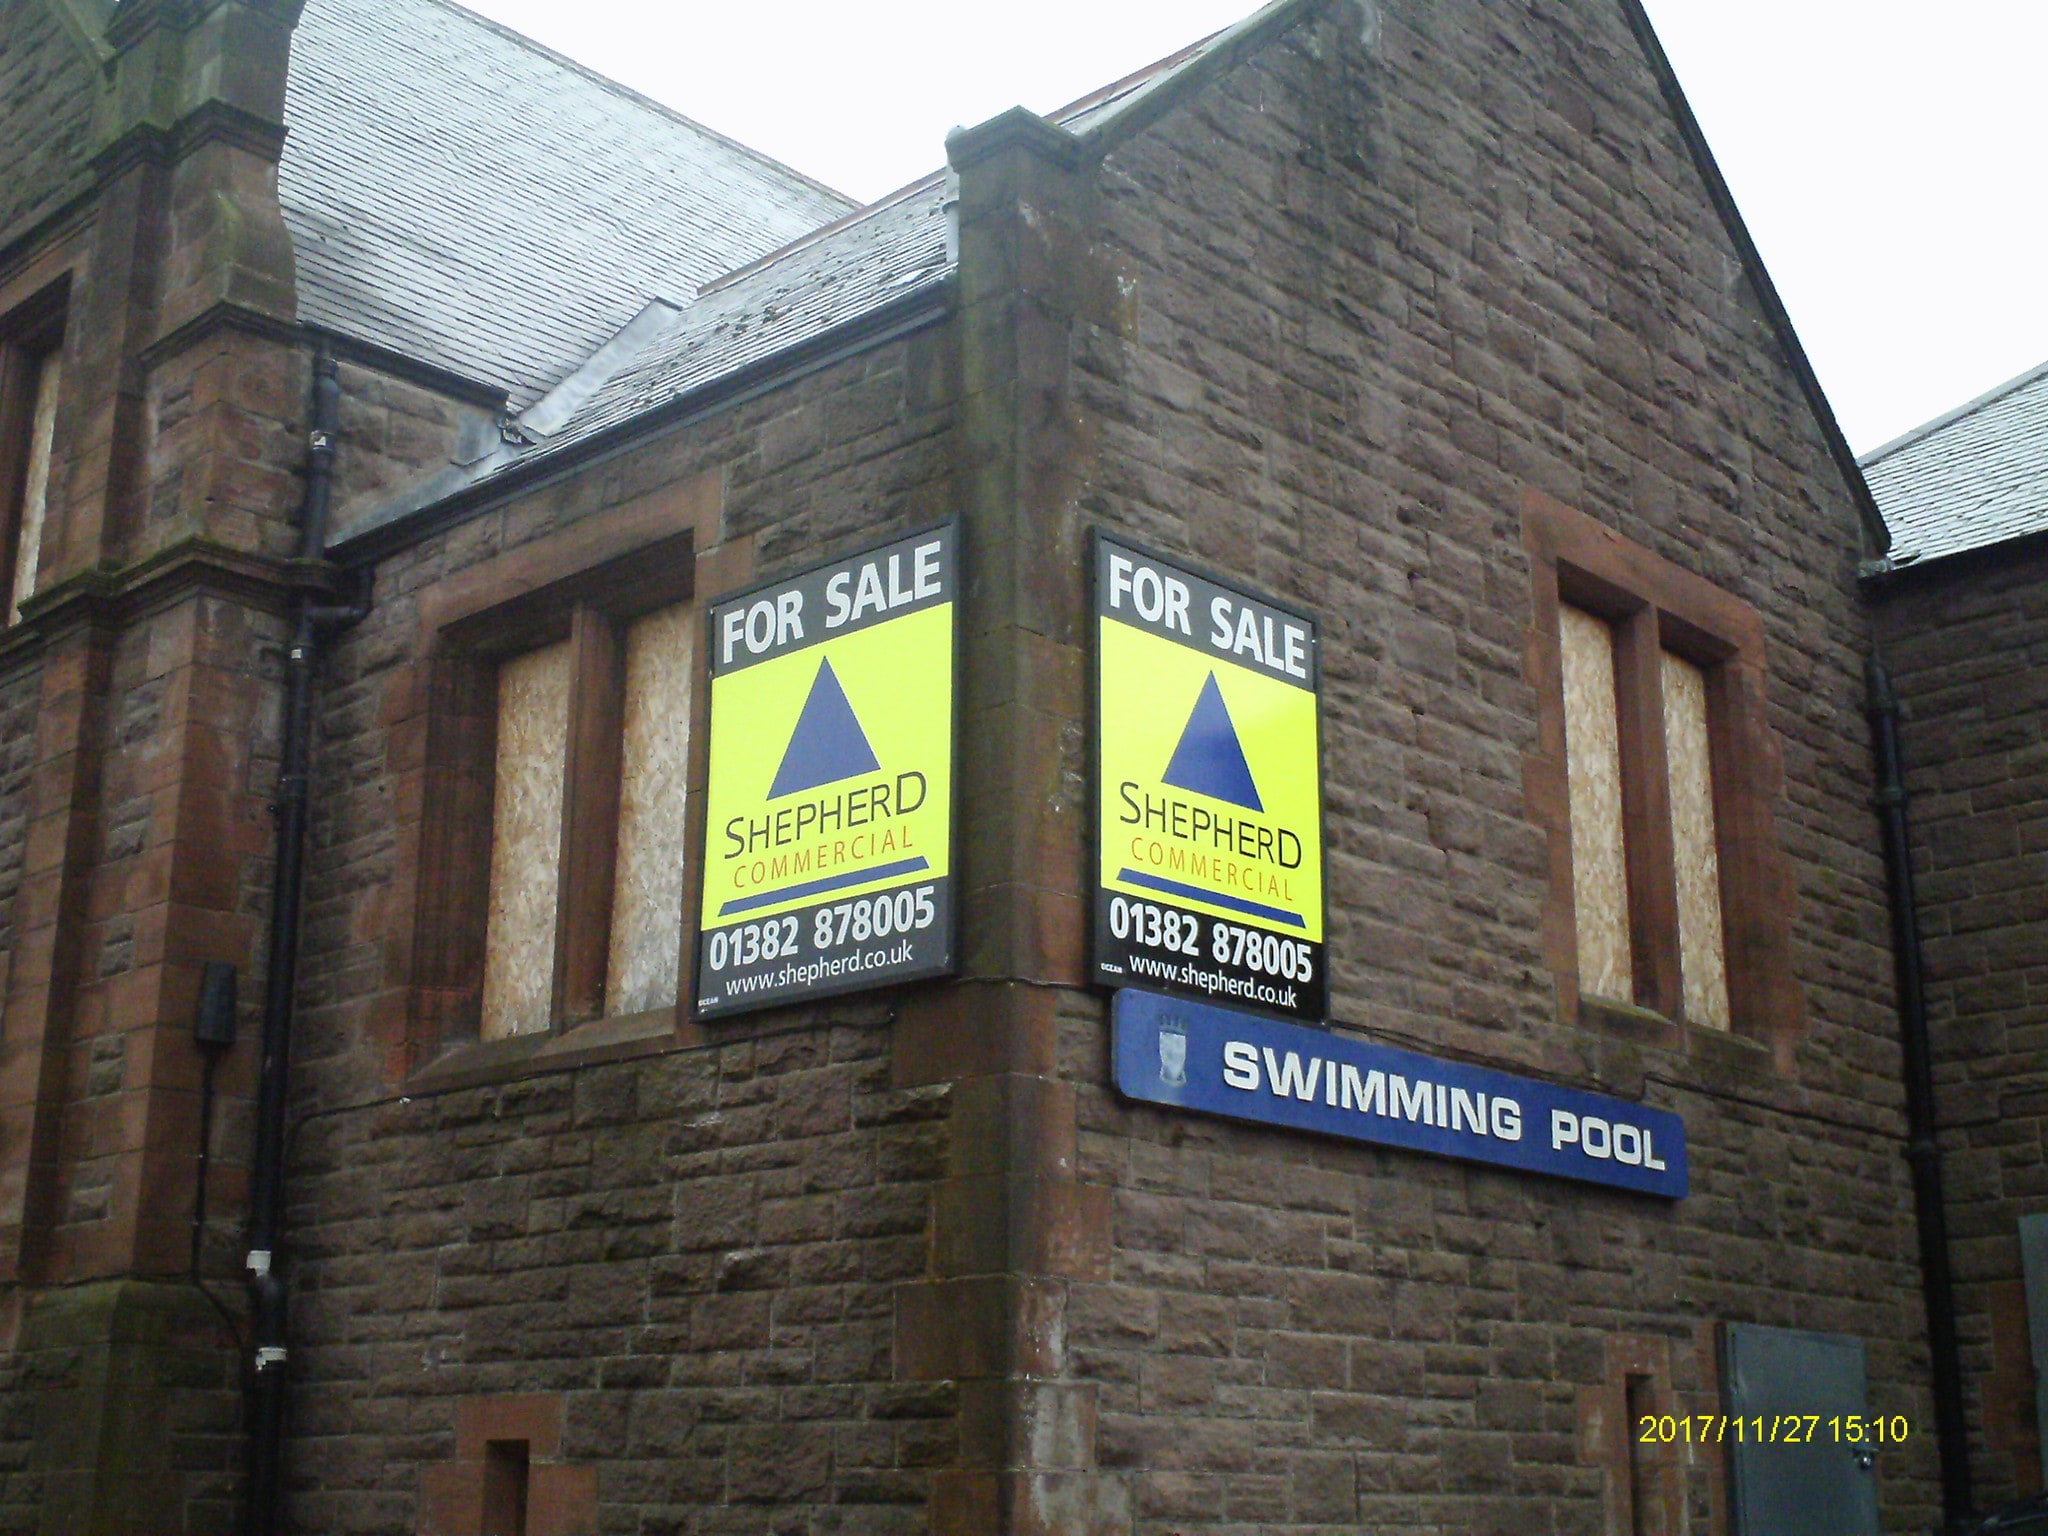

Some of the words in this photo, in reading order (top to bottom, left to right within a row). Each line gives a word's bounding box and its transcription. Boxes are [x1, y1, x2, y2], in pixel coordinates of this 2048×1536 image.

[723, 590, 804, 664] FOR
[825, 540, 941, 628] SALE
[1110, 554, 1191, 635] FOR
[1210, 596, 1306, 679] SALE
[724, 771, 927, 860] SHEPHERD
[733, 825, 913, 888] COMMERCIAL
[1119, 781, 1302, 869] SHEPHERD
[1131, 837, 1293, 901] COMMERCIAL
[709, 916, 799, 971] 01382
[813, 885, 935, 949] 878005
[725, 939, 913, 996] www.shepherd.co.uk
[1109, 896, 1200, 957] 01382
[1212, 922, 1312, 983] 878005
[1129, 954, 1297, 1008] www.shepherd.co.uk
[1222, 1040, 1521, 1141] SWIMMING
[1551, 1108, 1666, 1171] POOL
